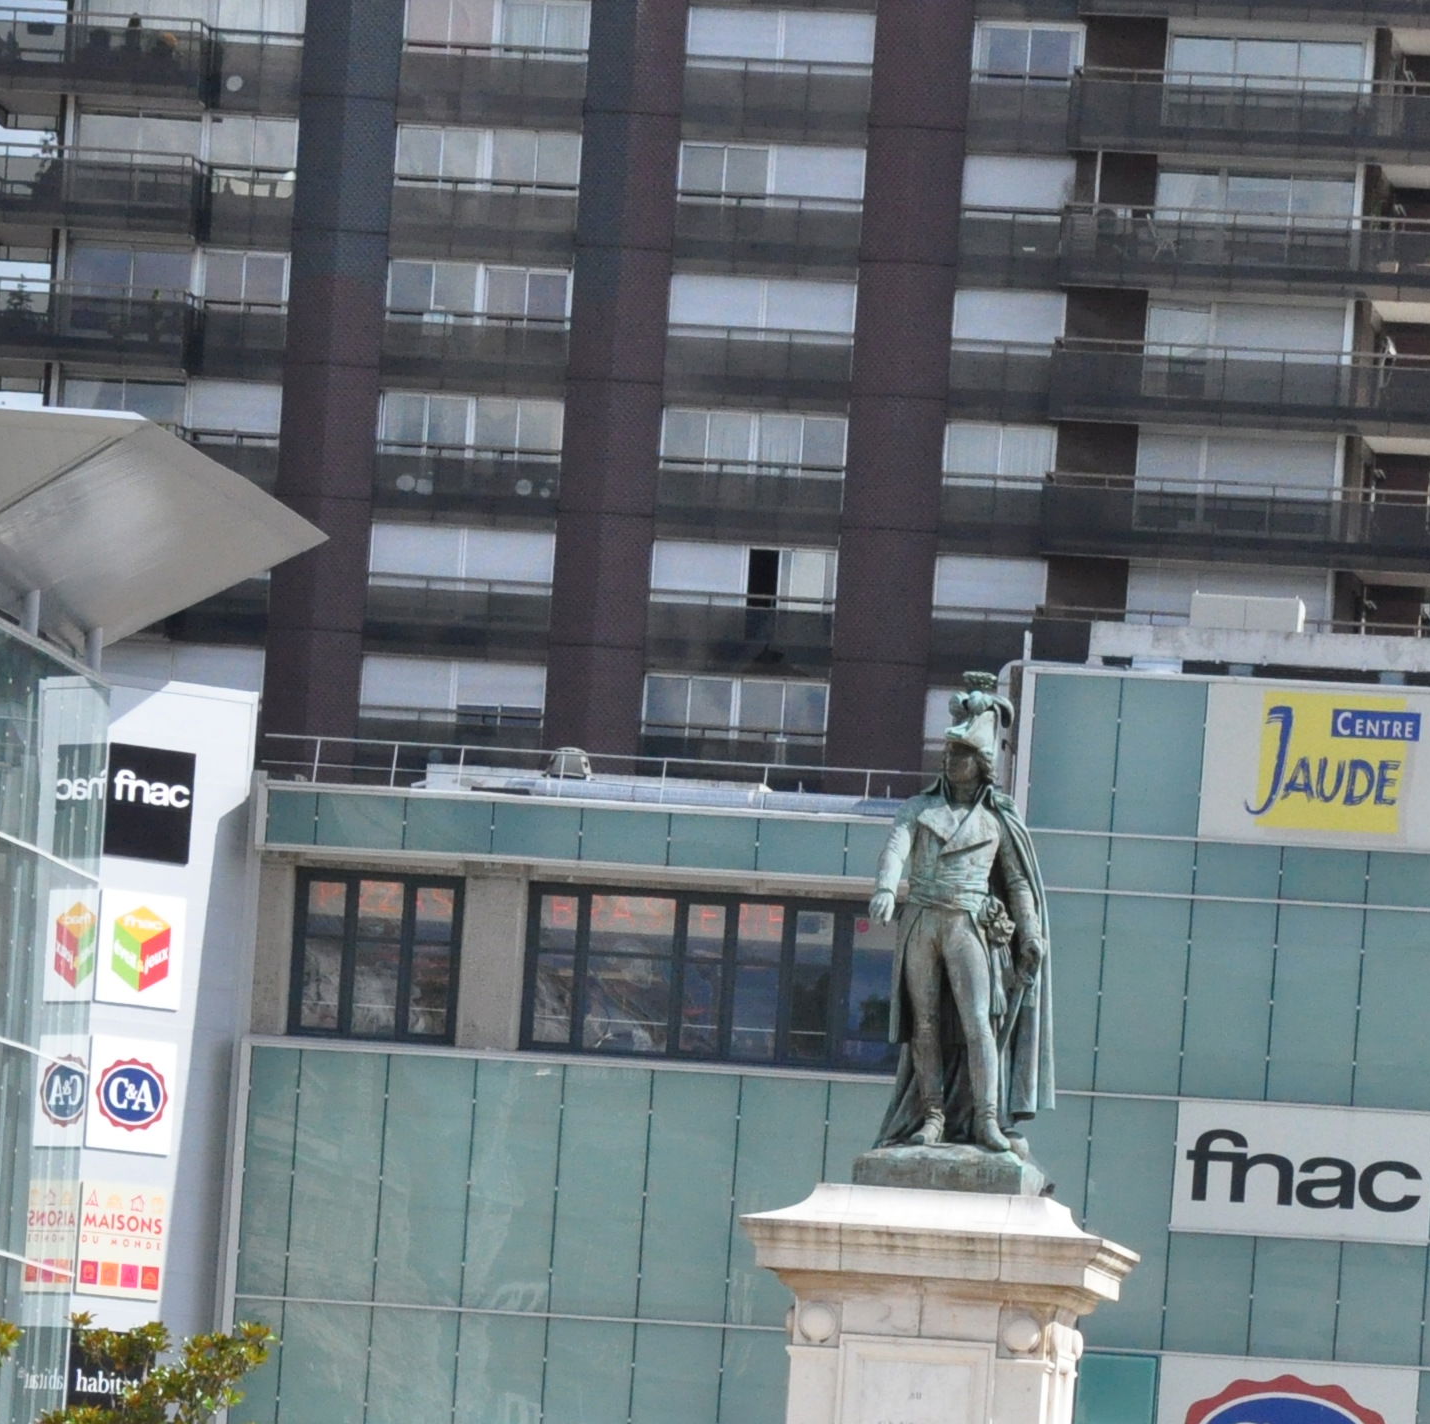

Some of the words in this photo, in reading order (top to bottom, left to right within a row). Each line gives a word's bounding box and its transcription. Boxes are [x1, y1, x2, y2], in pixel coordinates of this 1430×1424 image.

[1337, 711, 1414, 738] CENTRE
[1244, 705, 1401, 815] JAUDE
[114, 768, 191, 808] fnac
[108, 1076, 155, 1113] C&A
[1186, 1129, 1422, 1213] fnac
[83, 1211, 163, 1235] MAISONS
[81, 1233, 100, 1245] DU
[110, 1238, 162, 1252] MONDE
